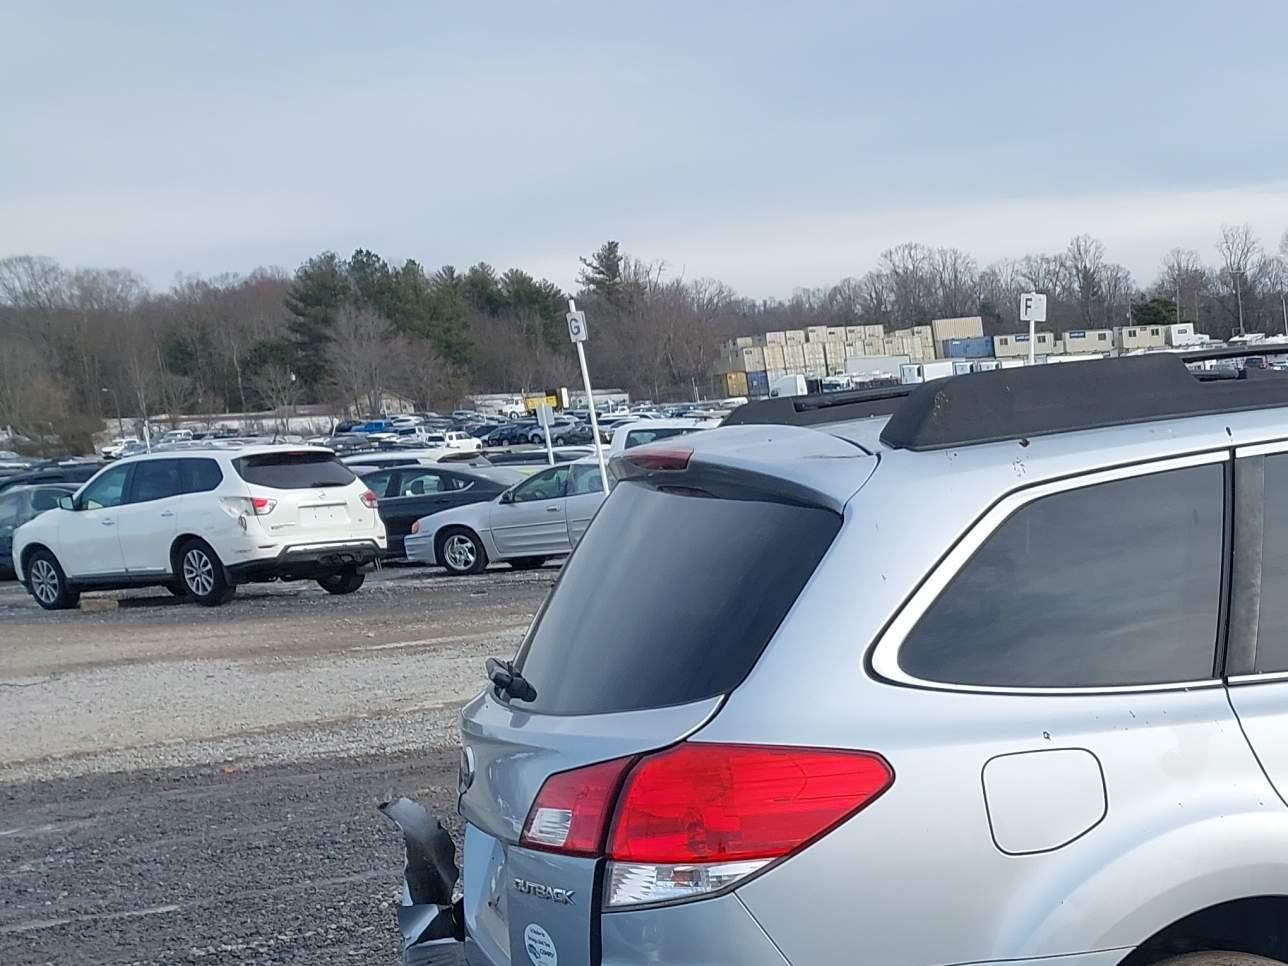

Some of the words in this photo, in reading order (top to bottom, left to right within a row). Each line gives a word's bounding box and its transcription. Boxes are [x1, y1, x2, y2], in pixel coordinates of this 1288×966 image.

[1024, 297, 1033, 316] F
[569, 318, 581, 336] G
[512, 878, 576, 905] OUTBACK
